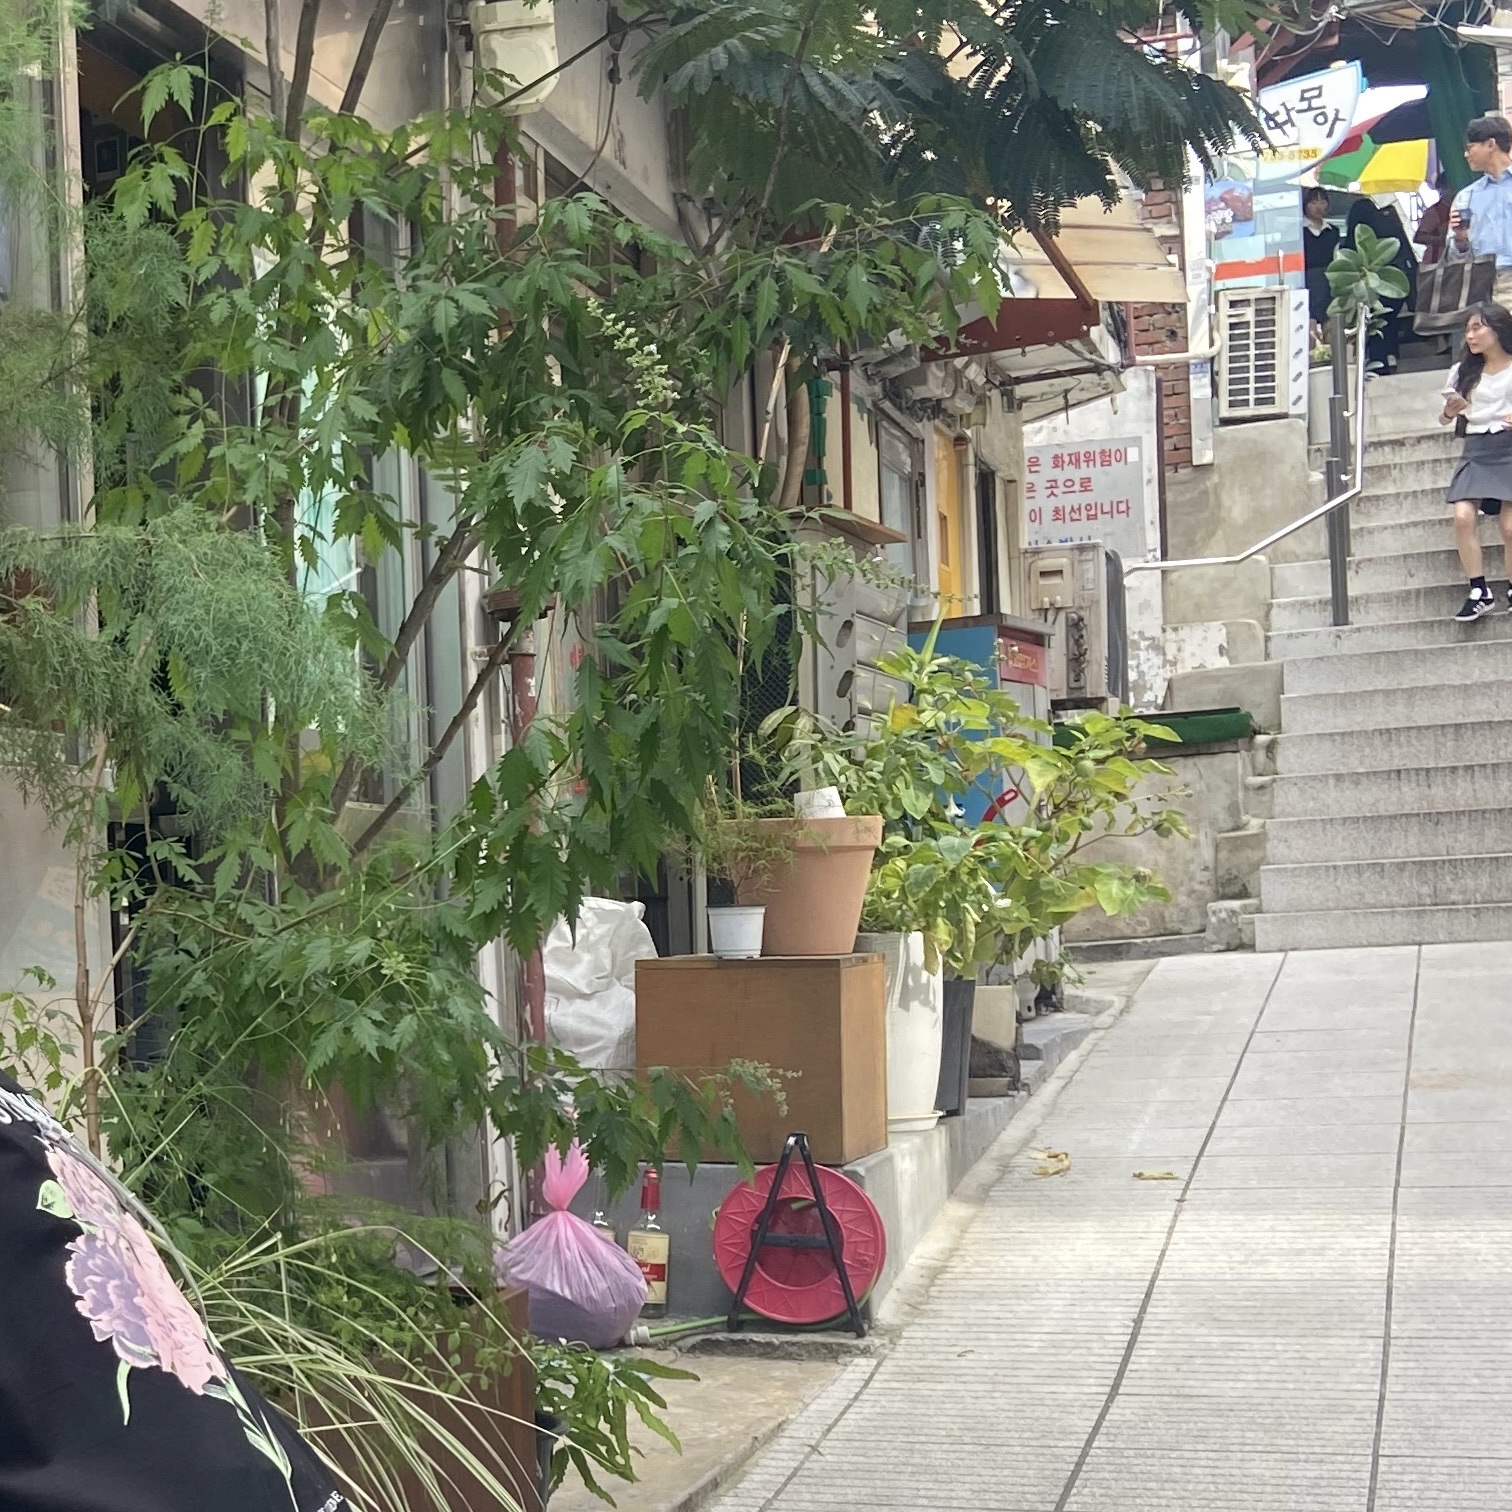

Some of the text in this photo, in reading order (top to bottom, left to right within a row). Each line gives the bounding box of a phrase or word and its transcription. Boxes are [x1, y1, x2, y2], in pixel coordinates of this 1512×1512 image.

[1051, 446, 1128, 471] 화재위험이
[1044, 476, 1094, 499] 곳으로
[1028, 498, 1132, 526] 이 최선입니다
